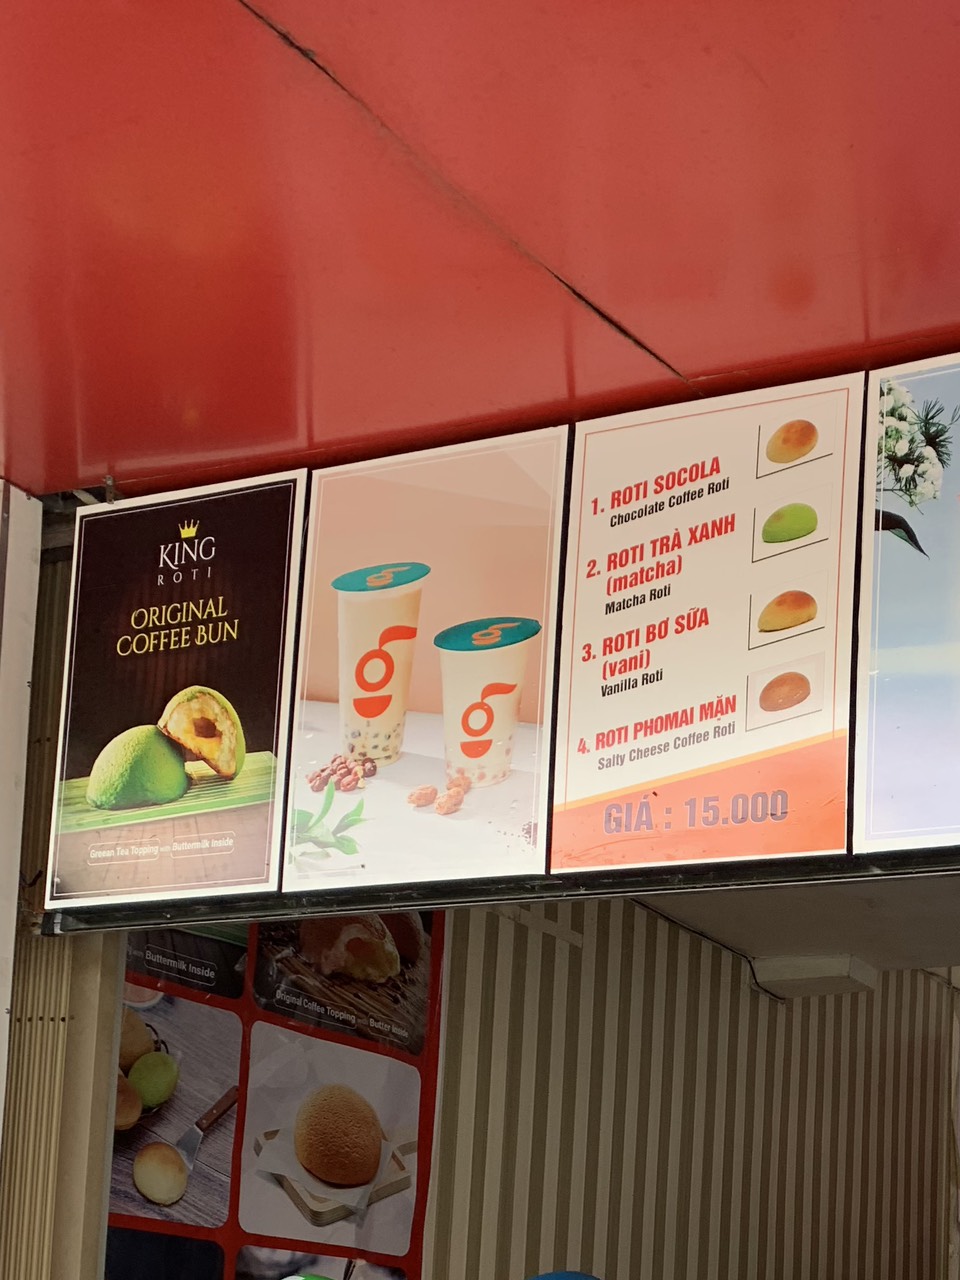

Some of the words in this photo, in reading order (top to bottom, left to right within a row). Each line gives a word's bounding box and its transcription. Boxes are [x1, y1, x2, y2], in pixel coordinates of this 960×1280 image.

[591, 498, 605, 515] 1.
[610, 481, 648, 510] ROTI
[653, 456, 721, 495] SOCOLA
[610, 501, 665, 528] Chocolate
[668, 487, 704, 509] Coffee
[708, 477, 730, 496] Roti
[159, 536, 216, 570] KING
[586, 559, 601, 579] 2.
[607, 544, 644, 572] ROTI
[650, 528, 681, 560] TRÀ
[687, 513, 736, 547] XANH
[157, 566, 211, 586] ROTI
[606, 555, 683, 596] (matcha)
[130, 596, 228, 630] ORIGINAL
[605, 593, 646, 616] Matcha
[649, 584, 671, 603] Roti
[116, 627, 191, 656] COFFEE
[195, 619, 239, 645] BUN
[582, 643, 597, 662] 3.
[602, 628, 640, 657] ROTI
[645, 617, 669, 644] BƠ
[674, 607, 710, 635] SỮA
[601, 673, 638, 698] Vanilla
[641, 668, 664, 686] Roti
[602, 649, 651, 681] (vani)
[577, 738, 591, 755] 4.
[595, 725, 628, 751] ROTI
[633, 707, 694, 740] PHOMAI
[699, 694, 737, 722] MẶN
[597, 750, 626, 771] Salty
[628, 742, 670, 763] Cheese
[673, 730, 710, 750] Coffee
[713, 721, 736, 739] Roti
[603, 794, 654, 834] GIÁ
[684, 789, 789, 828] 15.000
[116, 847, 130, 857] Tea
[131, 844, 159, 857] Topping
[172, 839, 210, 851] Buttermilk
[211, 837, 234, 847] Inside
[145, 950, 187, 972] Buttermilk
[188, 963, 216, 979] Inside
[275, 989, 302, 1006] Original
[303, 999, 325, 1014] Coffee
[326, 1006, 356, 1024] Topping
[369, 1018, 391, 1032] Butter
